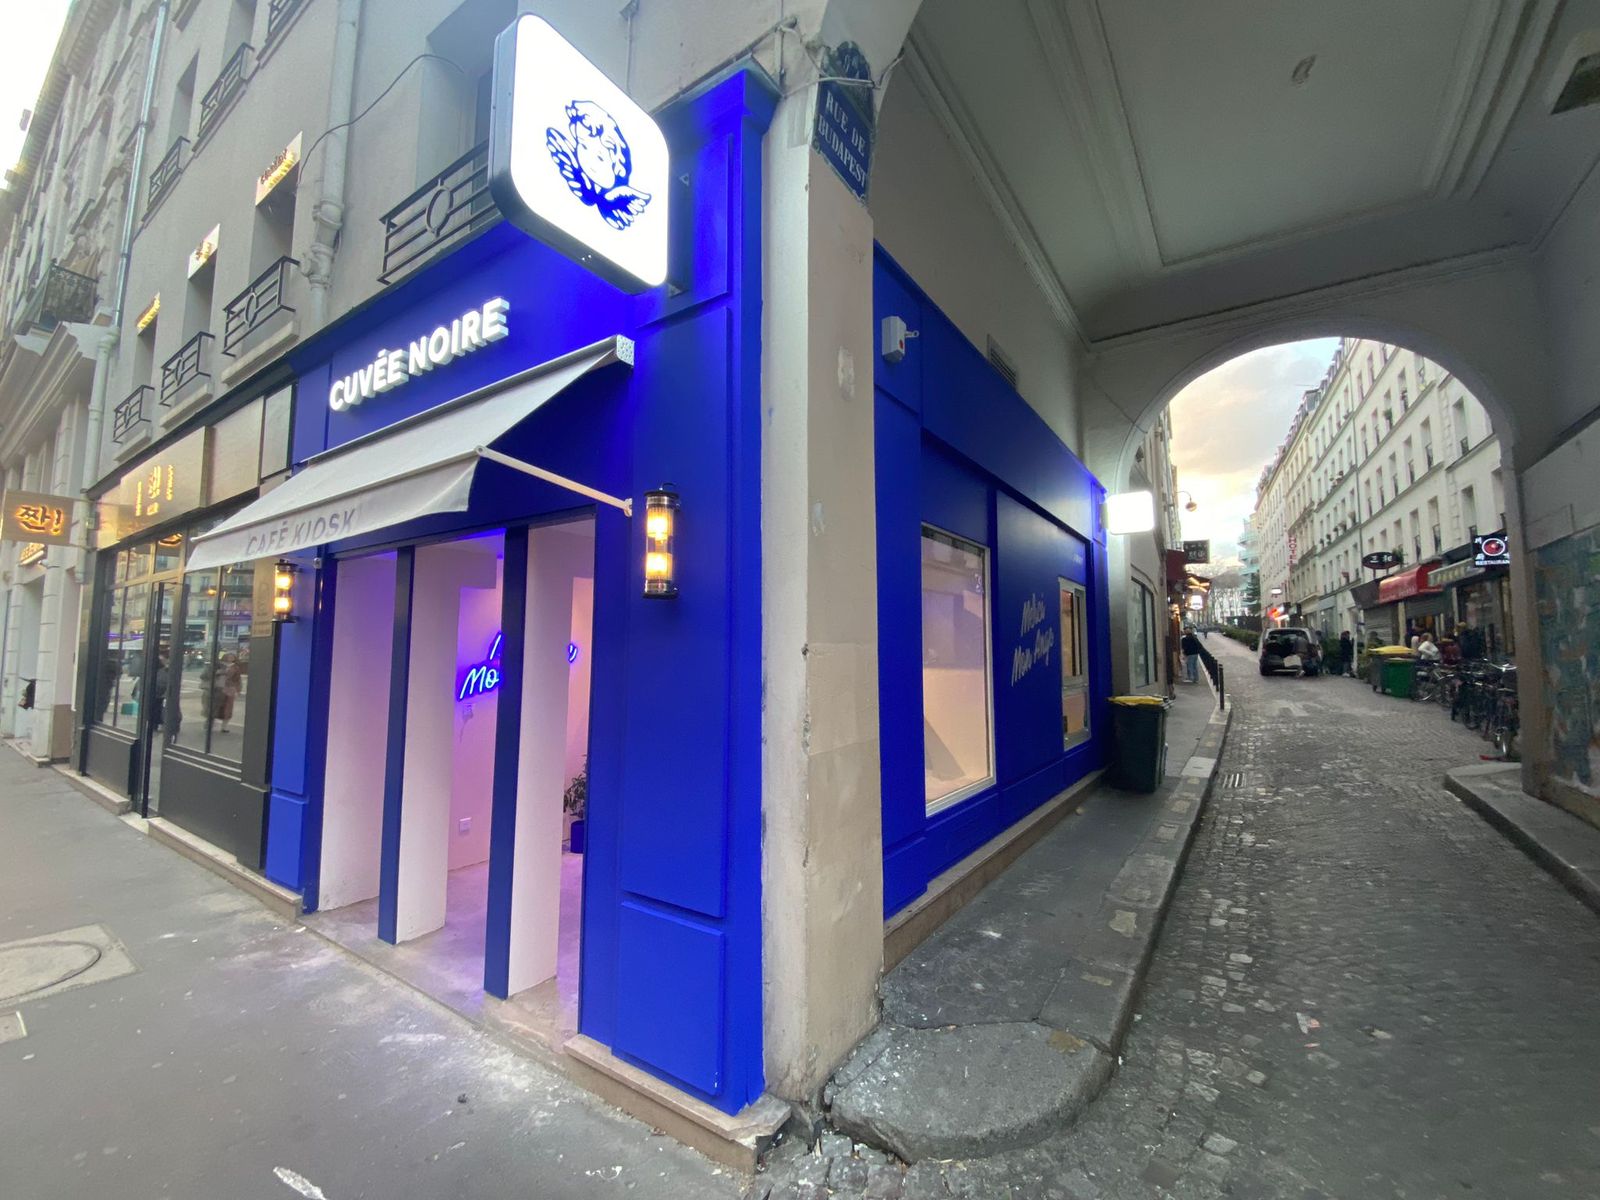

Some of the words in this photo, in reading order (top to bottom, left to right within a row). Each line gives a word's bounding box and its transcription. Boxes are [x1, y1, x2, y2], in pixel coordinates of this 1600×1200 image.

[817, 114, 867, 188] BUDAPEST
[826, 90, 849, 132] RUE
[851, 128, 866, 157] DE
[329, 348, 409, 412] CUVÉE
[408, 297, 510, 377] NOIRE
[246, 520, 286, 556] CAFÉ
[291, 508, 356, 547] KIOSK
[459, 665, 500, 699] Mo
